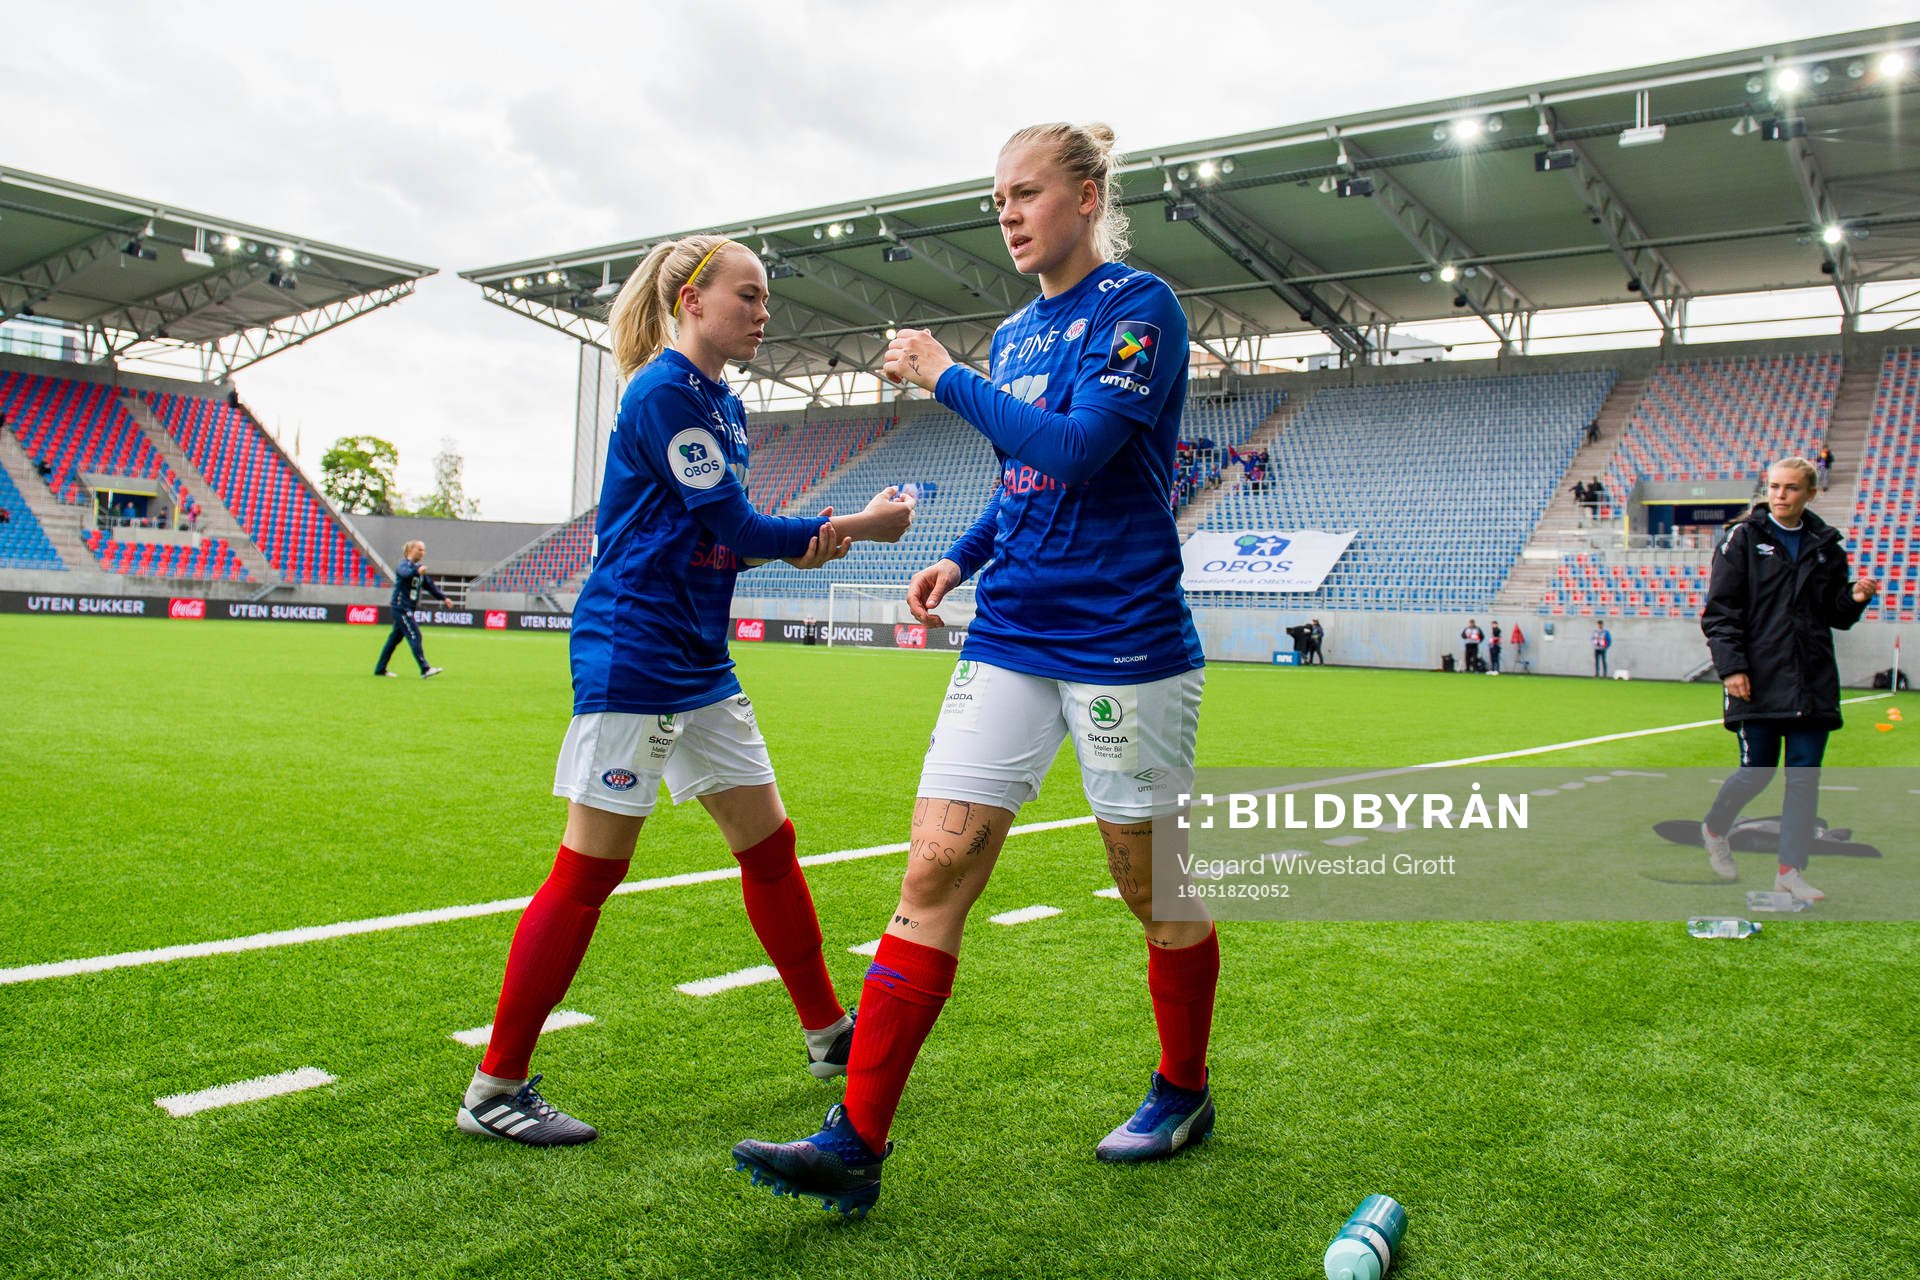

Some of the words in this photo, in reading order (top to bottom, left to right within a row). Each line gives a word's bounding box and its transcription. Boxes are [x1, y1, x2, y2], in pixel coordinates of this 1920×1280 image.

[1099, 374, 1150, 396] umbro
[684, 460, 720, 477] OBOS
[1202, 560, 1293, 573] OBOS
[28, 596, 73, 612] UTEN
[78, 598, 145, 614] SUKKER
[229, 603, 268, 618] UTEN
[271, 605, 328, 620] SUKKER
[413, 611, 431, 623] EN
[434, 611, 473, 625] SUKKER
[520, 616, 547, 628] UTEN
[547, 617, 573, 629] SUKK
[821, 627, 873, 642] SUKKER
[949, 631, 967, 645] UT
[1113, 655, 1147, 664] QUICKDRY
[1087, 733, 1129, 744] ŠKODA
[1137, 784, 1167, 793] umbro
